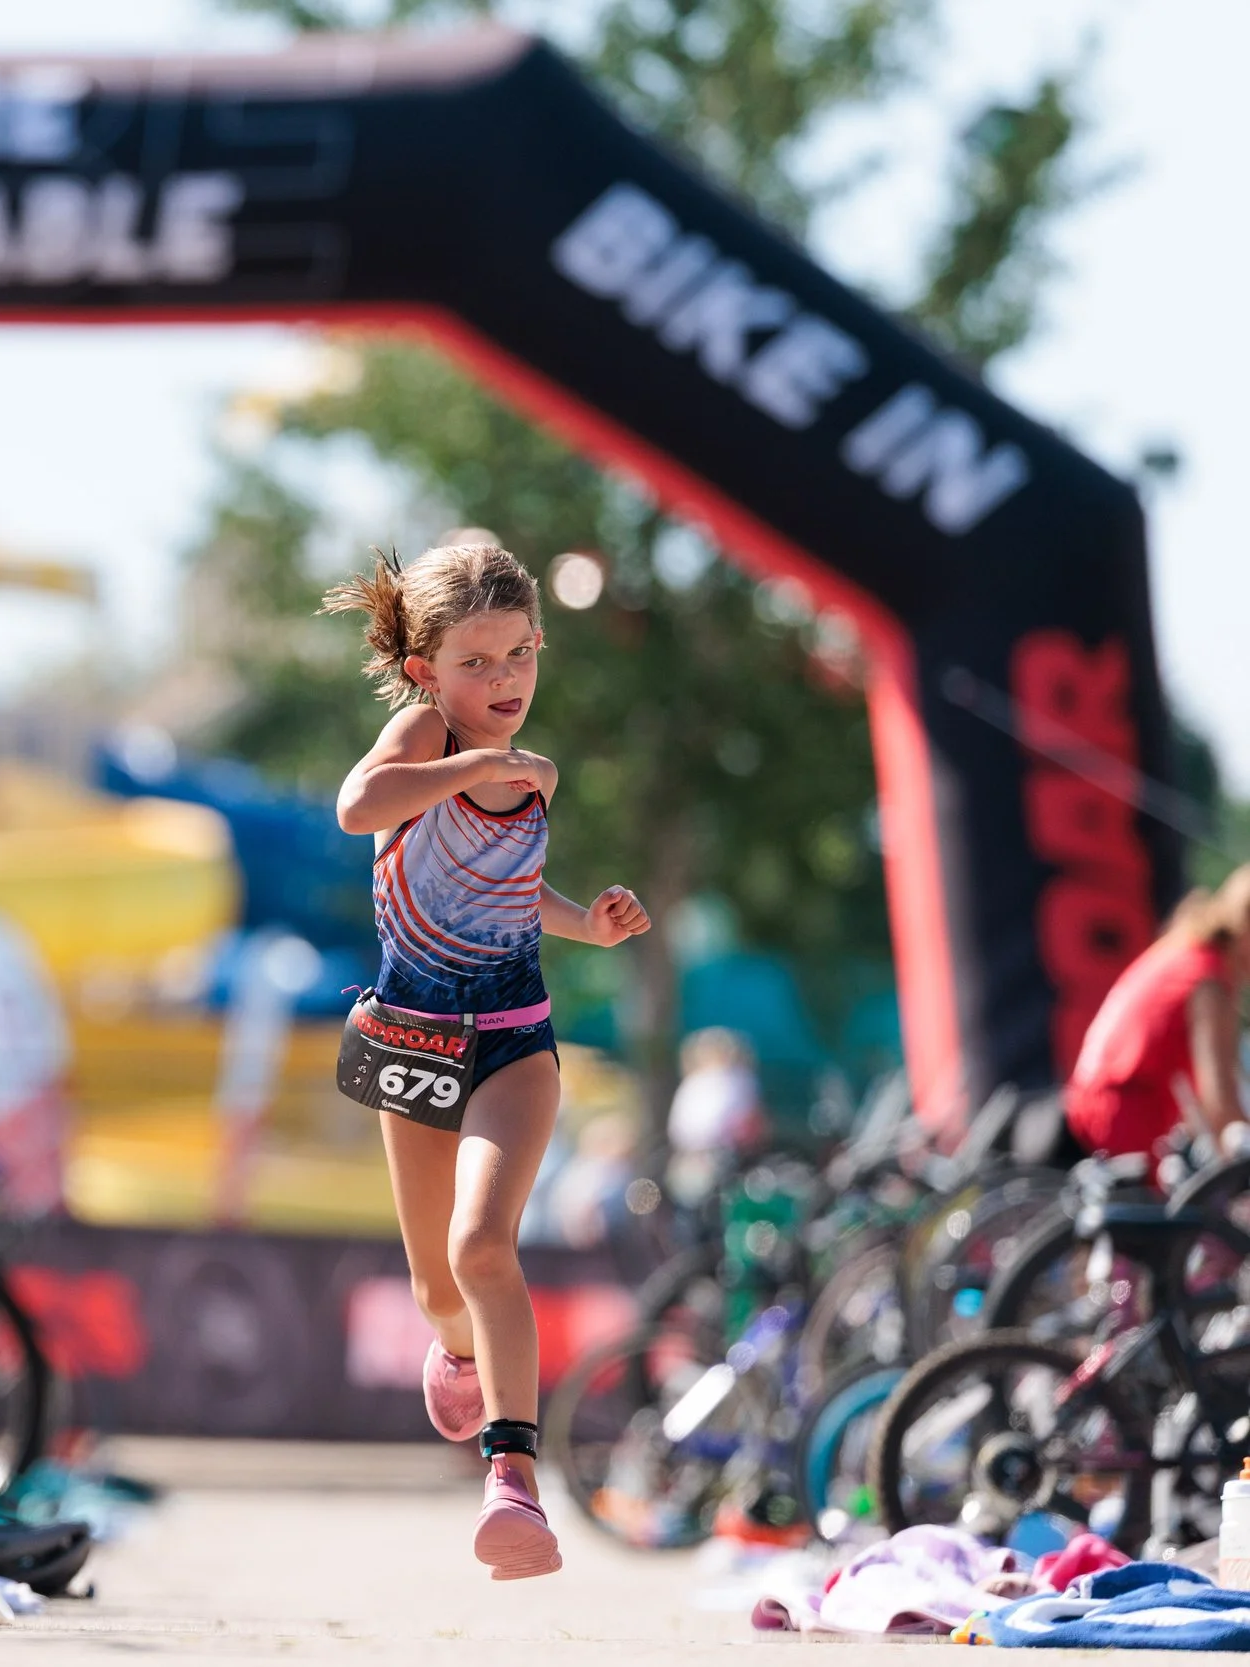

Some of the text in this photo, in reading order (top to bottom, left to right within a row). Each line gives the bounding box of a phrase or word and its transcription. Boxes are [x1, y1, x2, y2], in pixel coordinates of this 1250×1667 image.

[553, 182, 1028, 535] BIKE IN
[352, 1008, 464, 1059] RIPROAR
[361, 1017, 444, 1048] TRIATHLETE
[477, 1017, 505, 1026] HAN
[378, 1064, 461, 1109] 679
